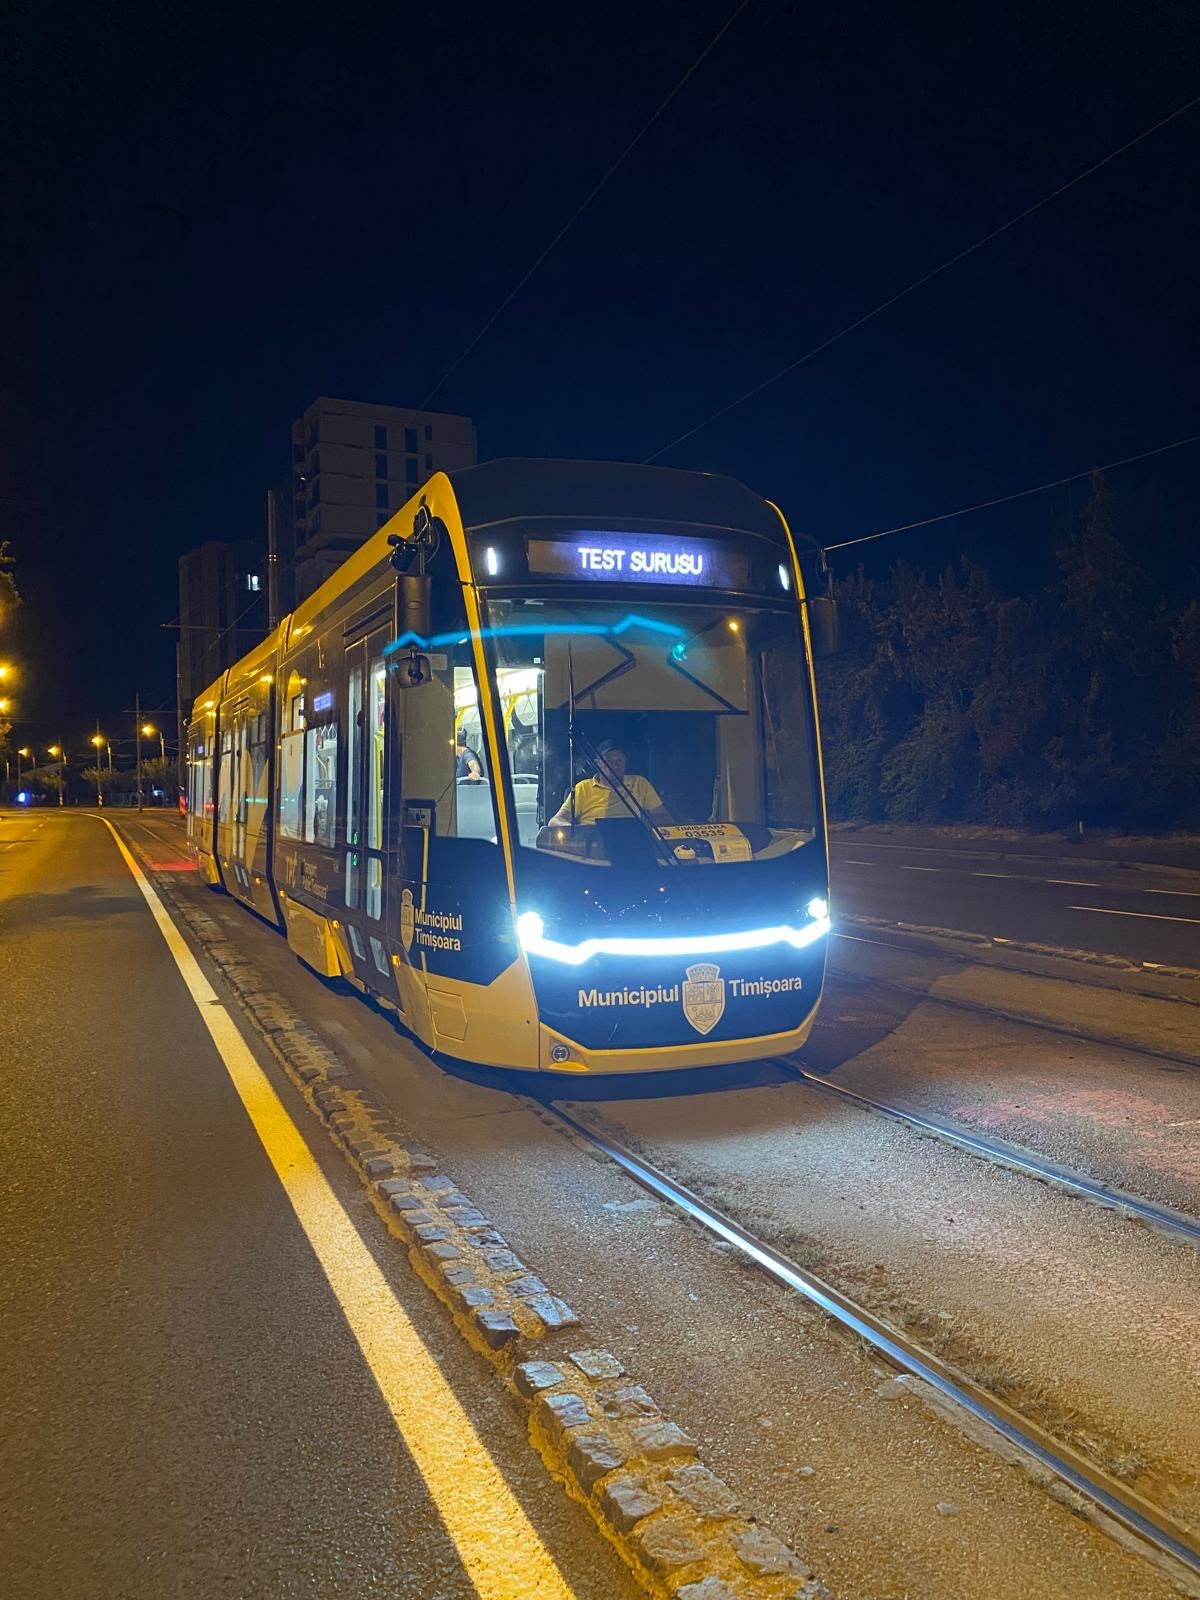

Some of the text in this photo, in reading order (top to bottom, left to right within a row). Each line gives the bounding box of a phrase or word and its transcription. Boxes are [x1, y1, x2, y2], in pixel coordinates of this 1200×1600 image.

[577, 547, 703, 575] TEST SURUSU
[684, 830, 726, 838] 03535
[414, 908, 463, 933] Municipiul
[414, 927, 461, 952] Timișoara
[578, 976, 802, 1008] Municipiul Timișoara
